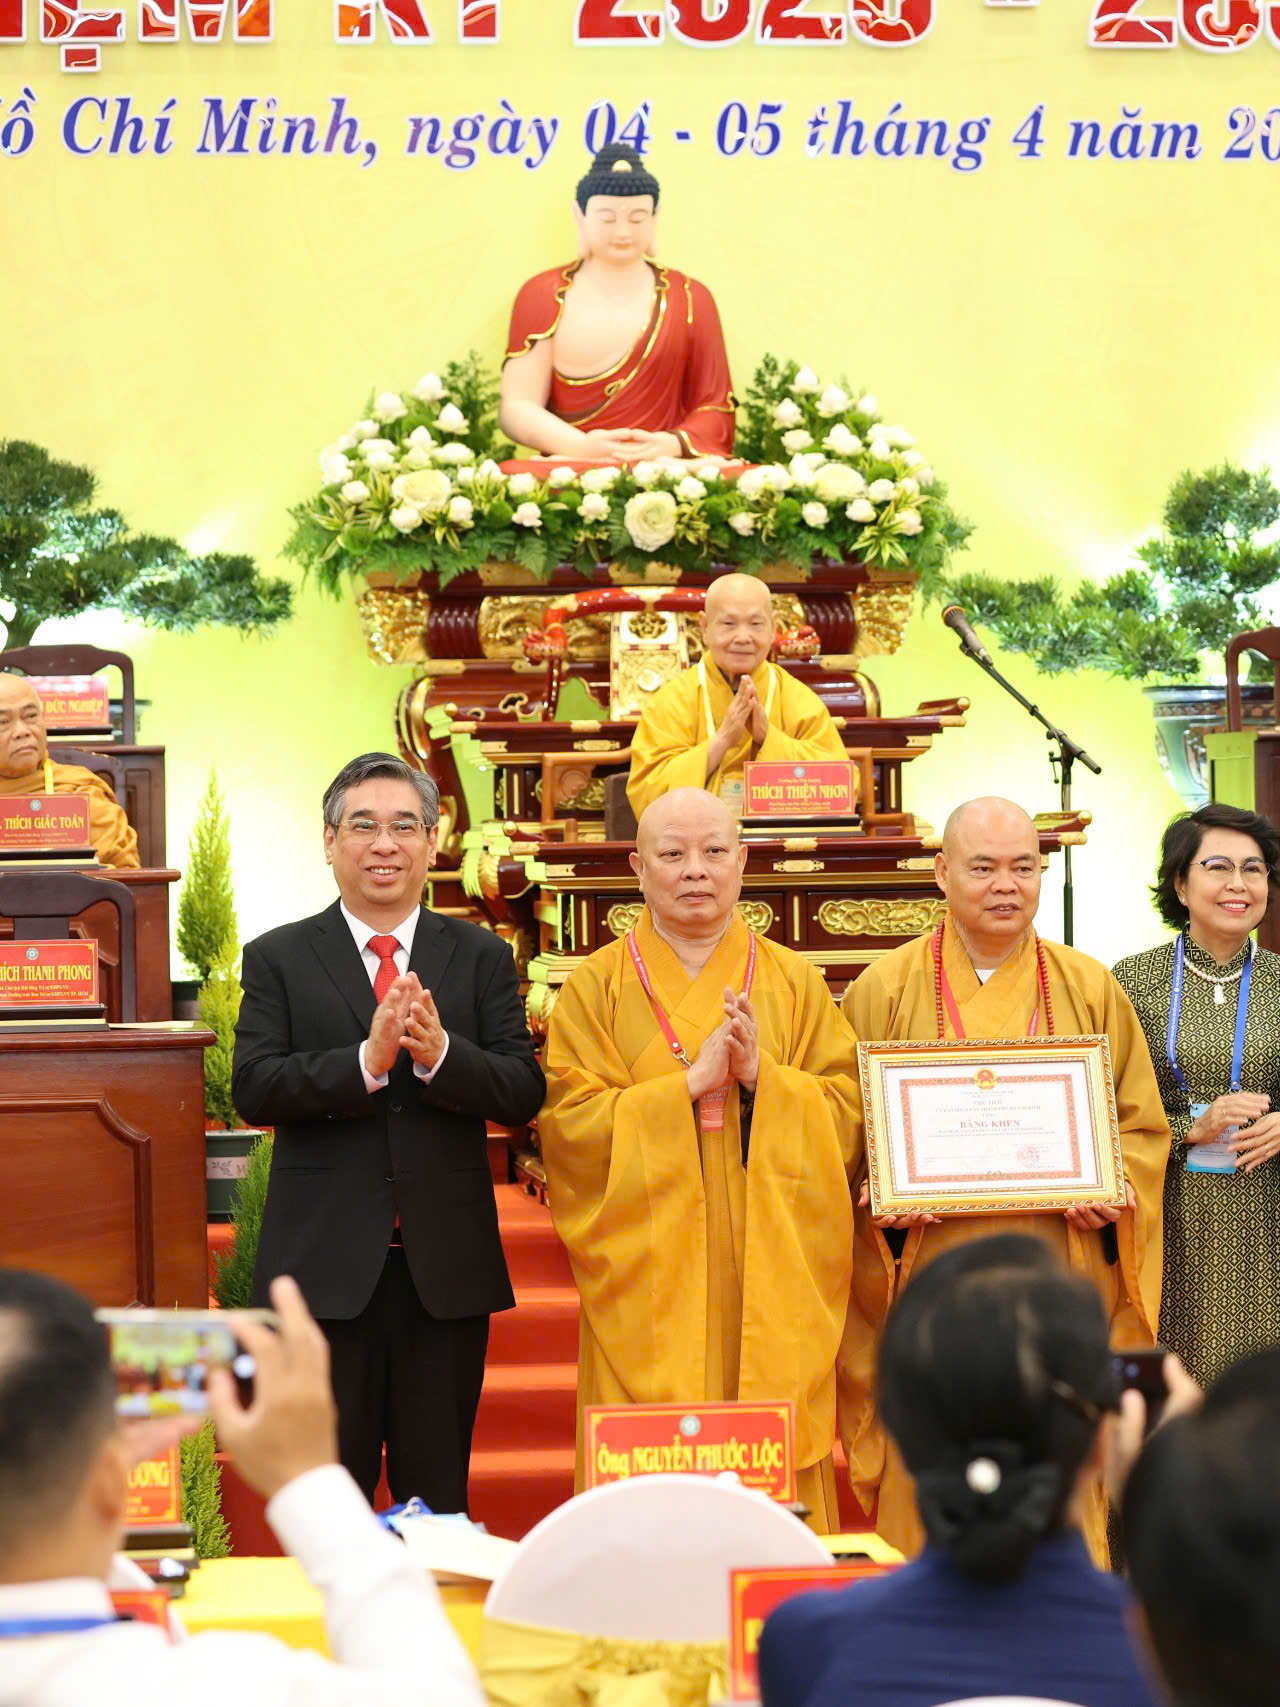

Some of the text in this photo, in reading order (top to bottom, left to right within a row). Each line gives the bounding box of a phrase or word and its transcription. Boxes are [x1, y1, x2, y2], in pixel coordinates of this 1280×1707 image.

[0, 87, 36, 155] ồ
[63, 97, 176, 154] Chí
[196, 98, 377, 166] Minh,
[406, 100, 559, 169] ngày
[584, 101, 650, 156] 04
[676, 131, 690, 140] -
[717, 102, 782, 156] 05
[807, 101, 991, 171] tháng
[1012, 105, 1045, 157] 4
[1067, 105, 1202, 160] năm
[751, 782, 784, 799] THÍCH
[786, 781, 817, 802] THIỆN
[4, 813, 85, 829] THÍCH GIÁC TOÀN
[22, 965, 55, 981] THANH
[58, 965, 91, 980] PHONG
[597, 1434, 783, 1480] Ông NGUYỄN PHƯỚC LỘC
